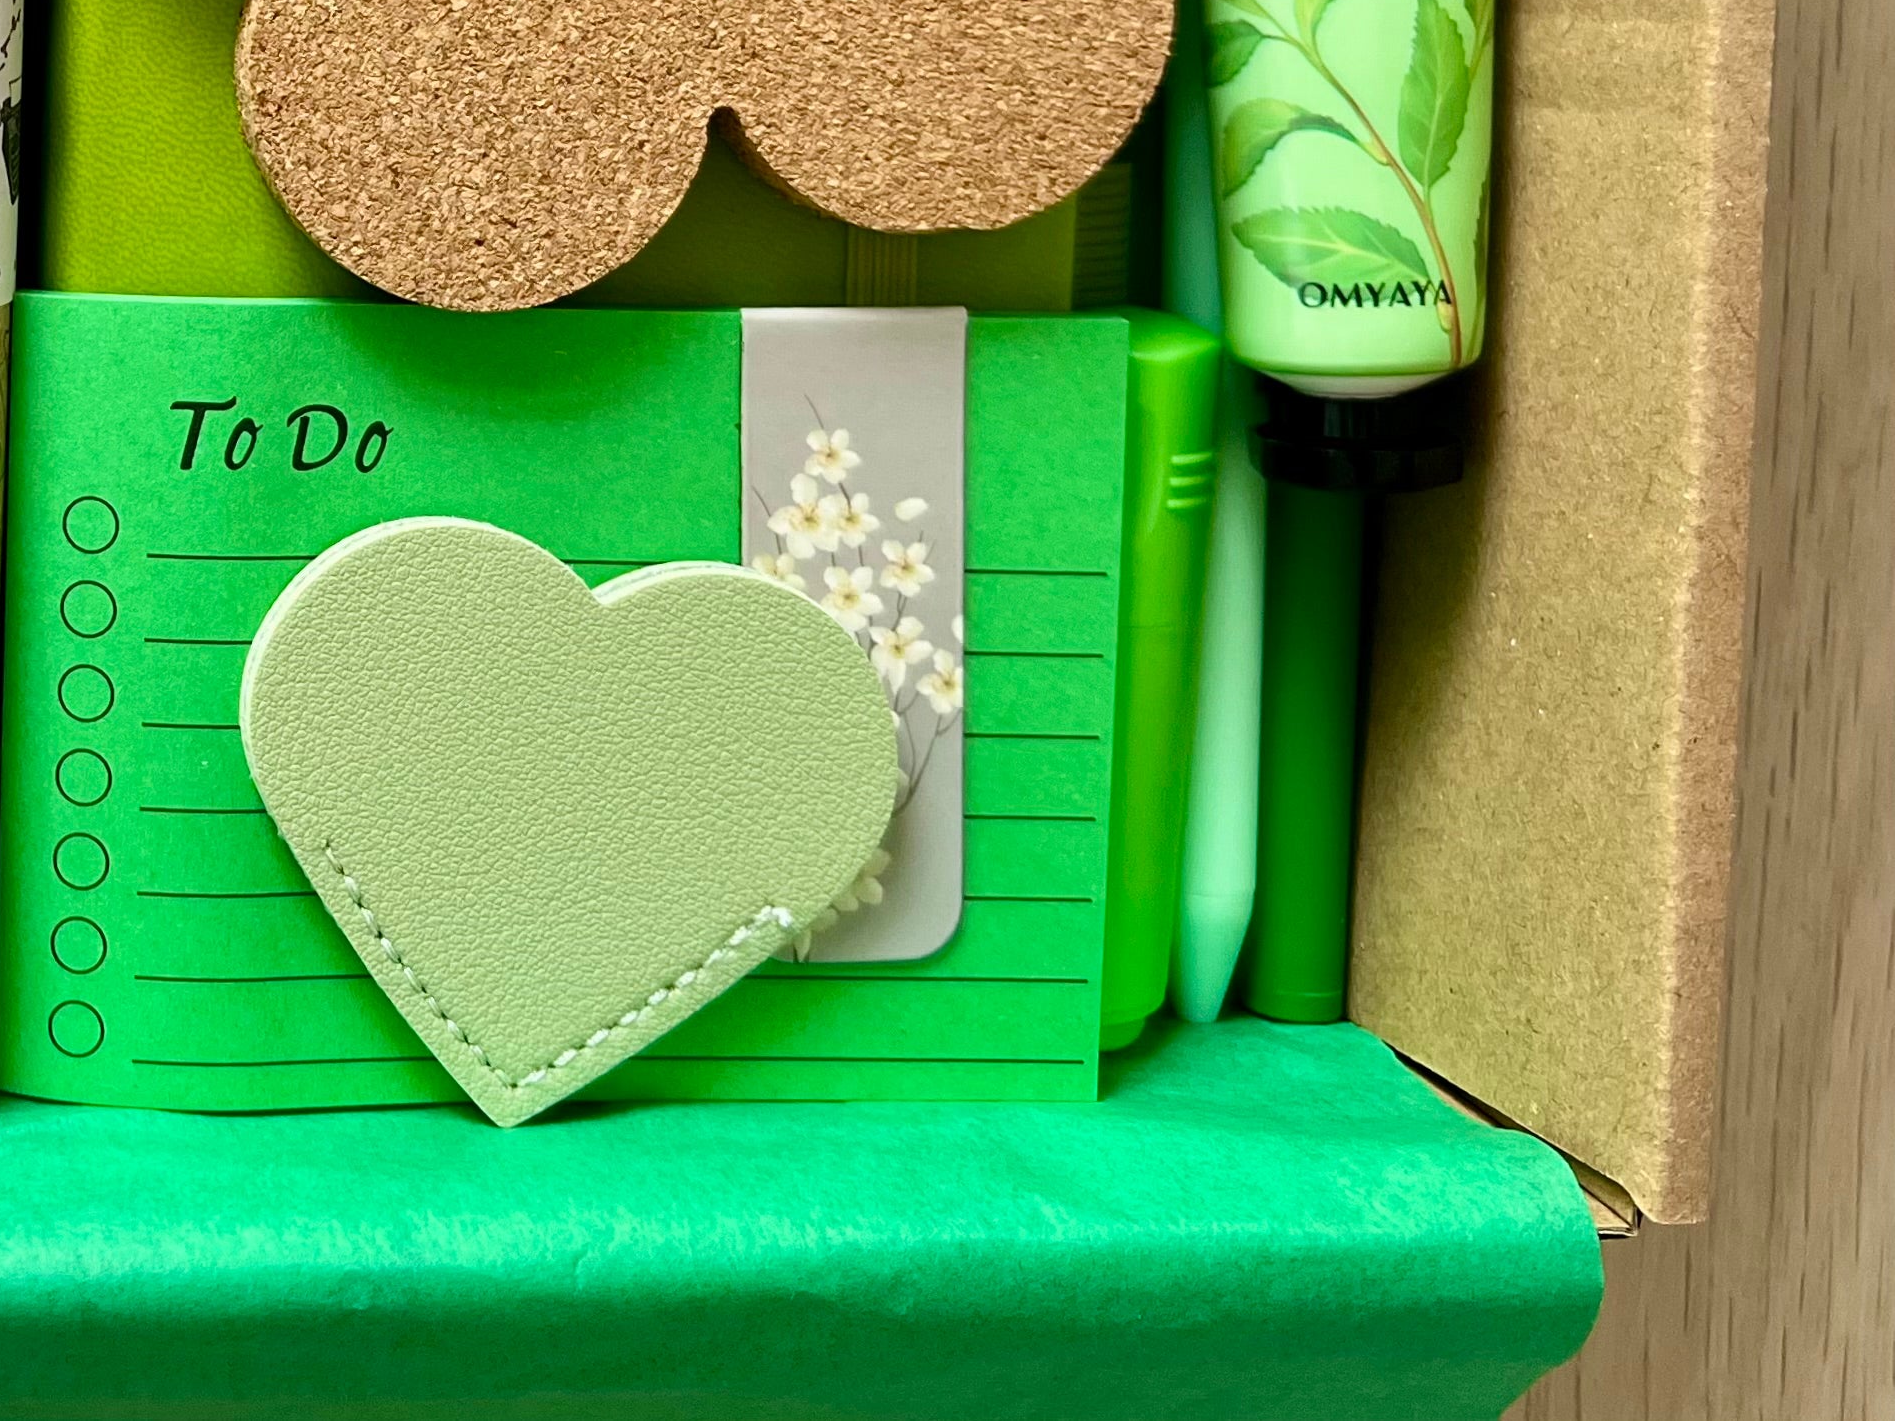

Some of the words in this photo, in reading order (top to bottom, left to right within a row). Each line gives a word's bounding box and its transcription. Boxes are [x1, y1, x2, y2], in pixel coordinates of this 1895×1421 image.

[1298, 279, 1452, 309] OMYAYA
[169, 395, 262, 471] To
[285, 401, 395, 475] Do
